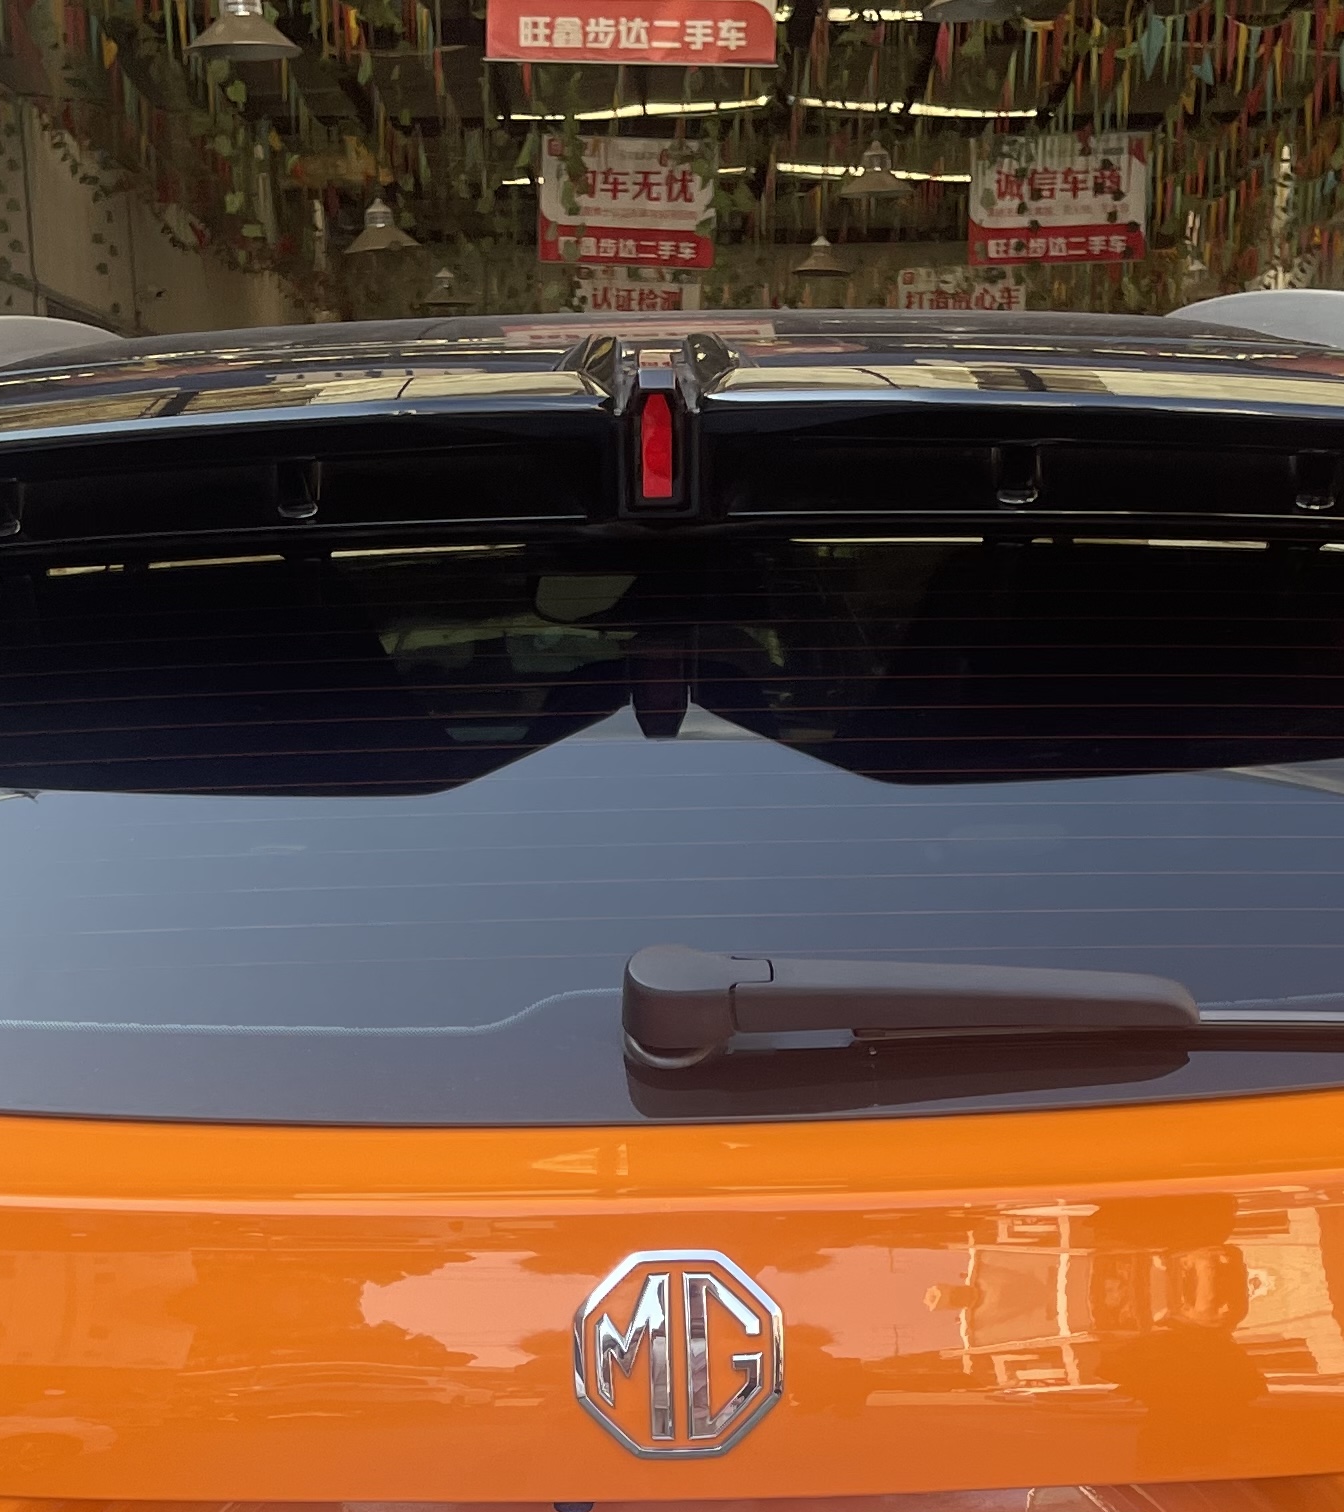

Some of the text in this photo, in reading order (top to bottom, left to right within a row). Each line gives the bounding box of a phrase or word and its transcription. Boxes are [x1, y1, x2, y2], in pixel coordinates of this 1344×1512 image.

[519, 17, 747, 50] 旺鑫步达二手车
[592, 1270, 766, 1444] MG
